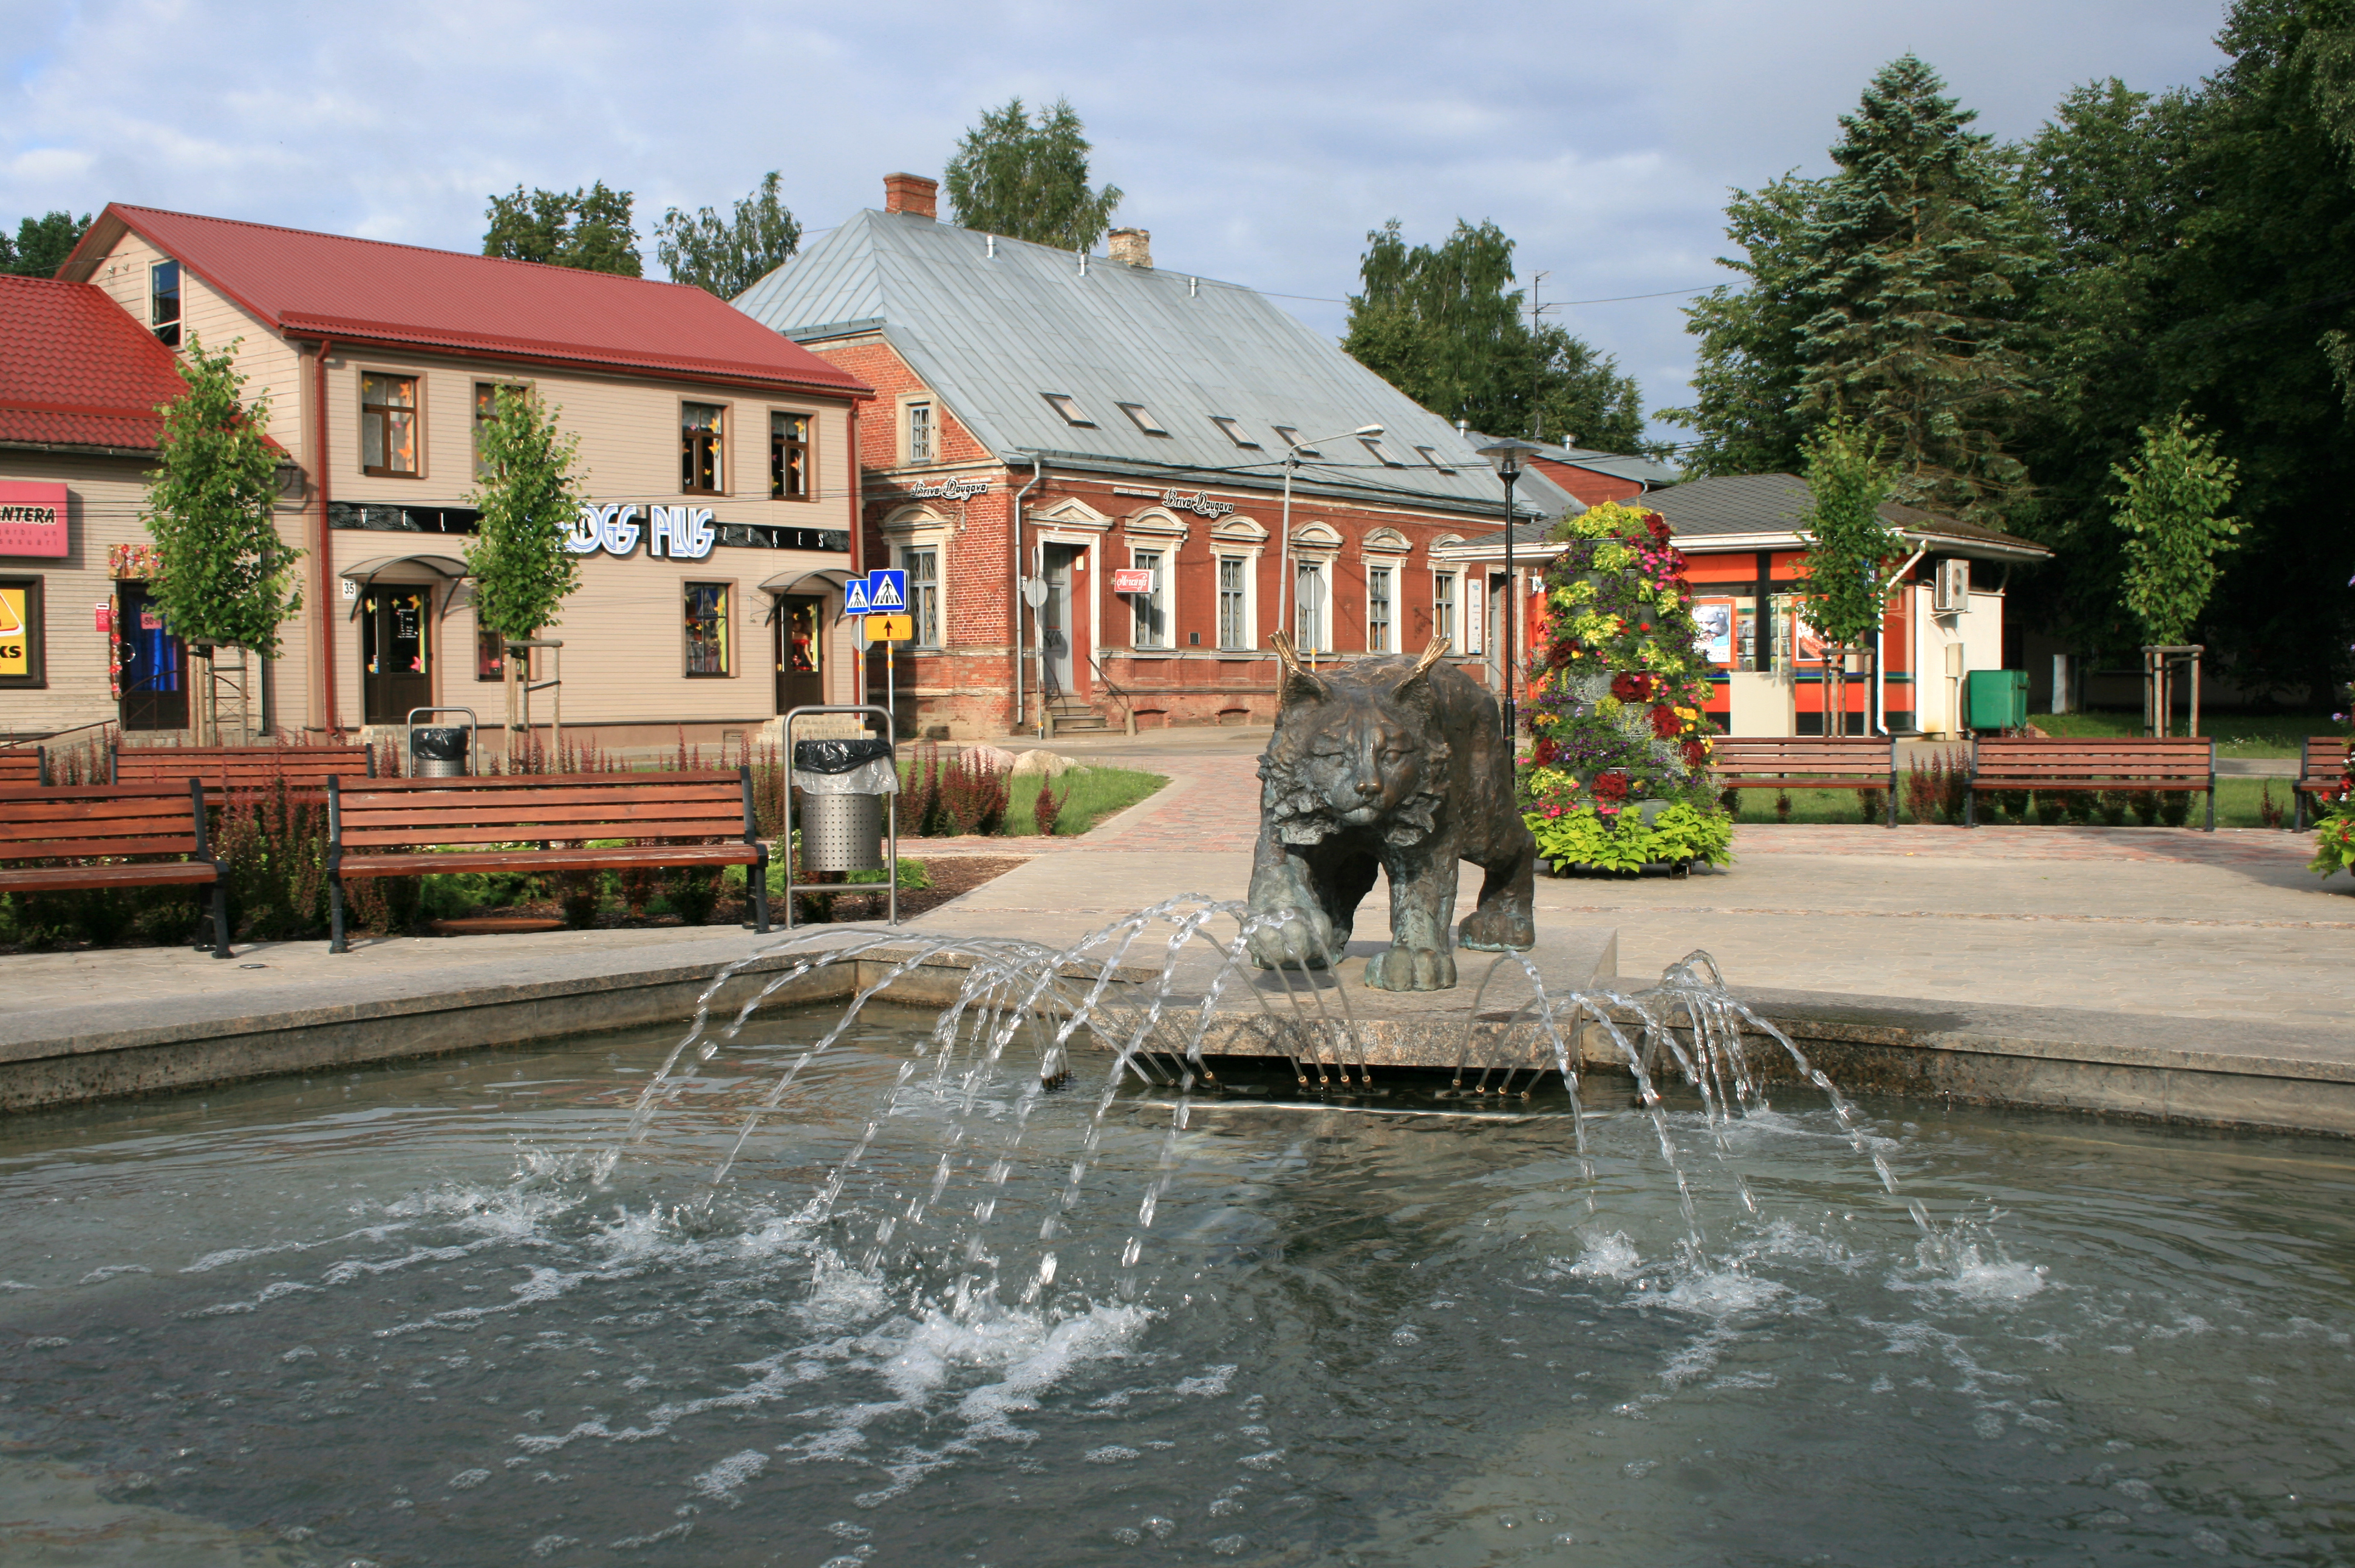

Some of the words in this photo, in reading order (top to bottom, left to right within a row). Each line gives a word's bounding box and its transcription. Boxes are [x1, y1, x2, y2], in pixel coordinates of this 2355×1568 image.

[941, 476, 987, 500] Daugava
[0, 505, 56, 525] NTERA
[1192, 490, 1233, 518] Daugava
[360, 508, 487, 532] VEĻ
[649, 505, 715, 558] PLUS
[344, 582, 355, 595] 35
